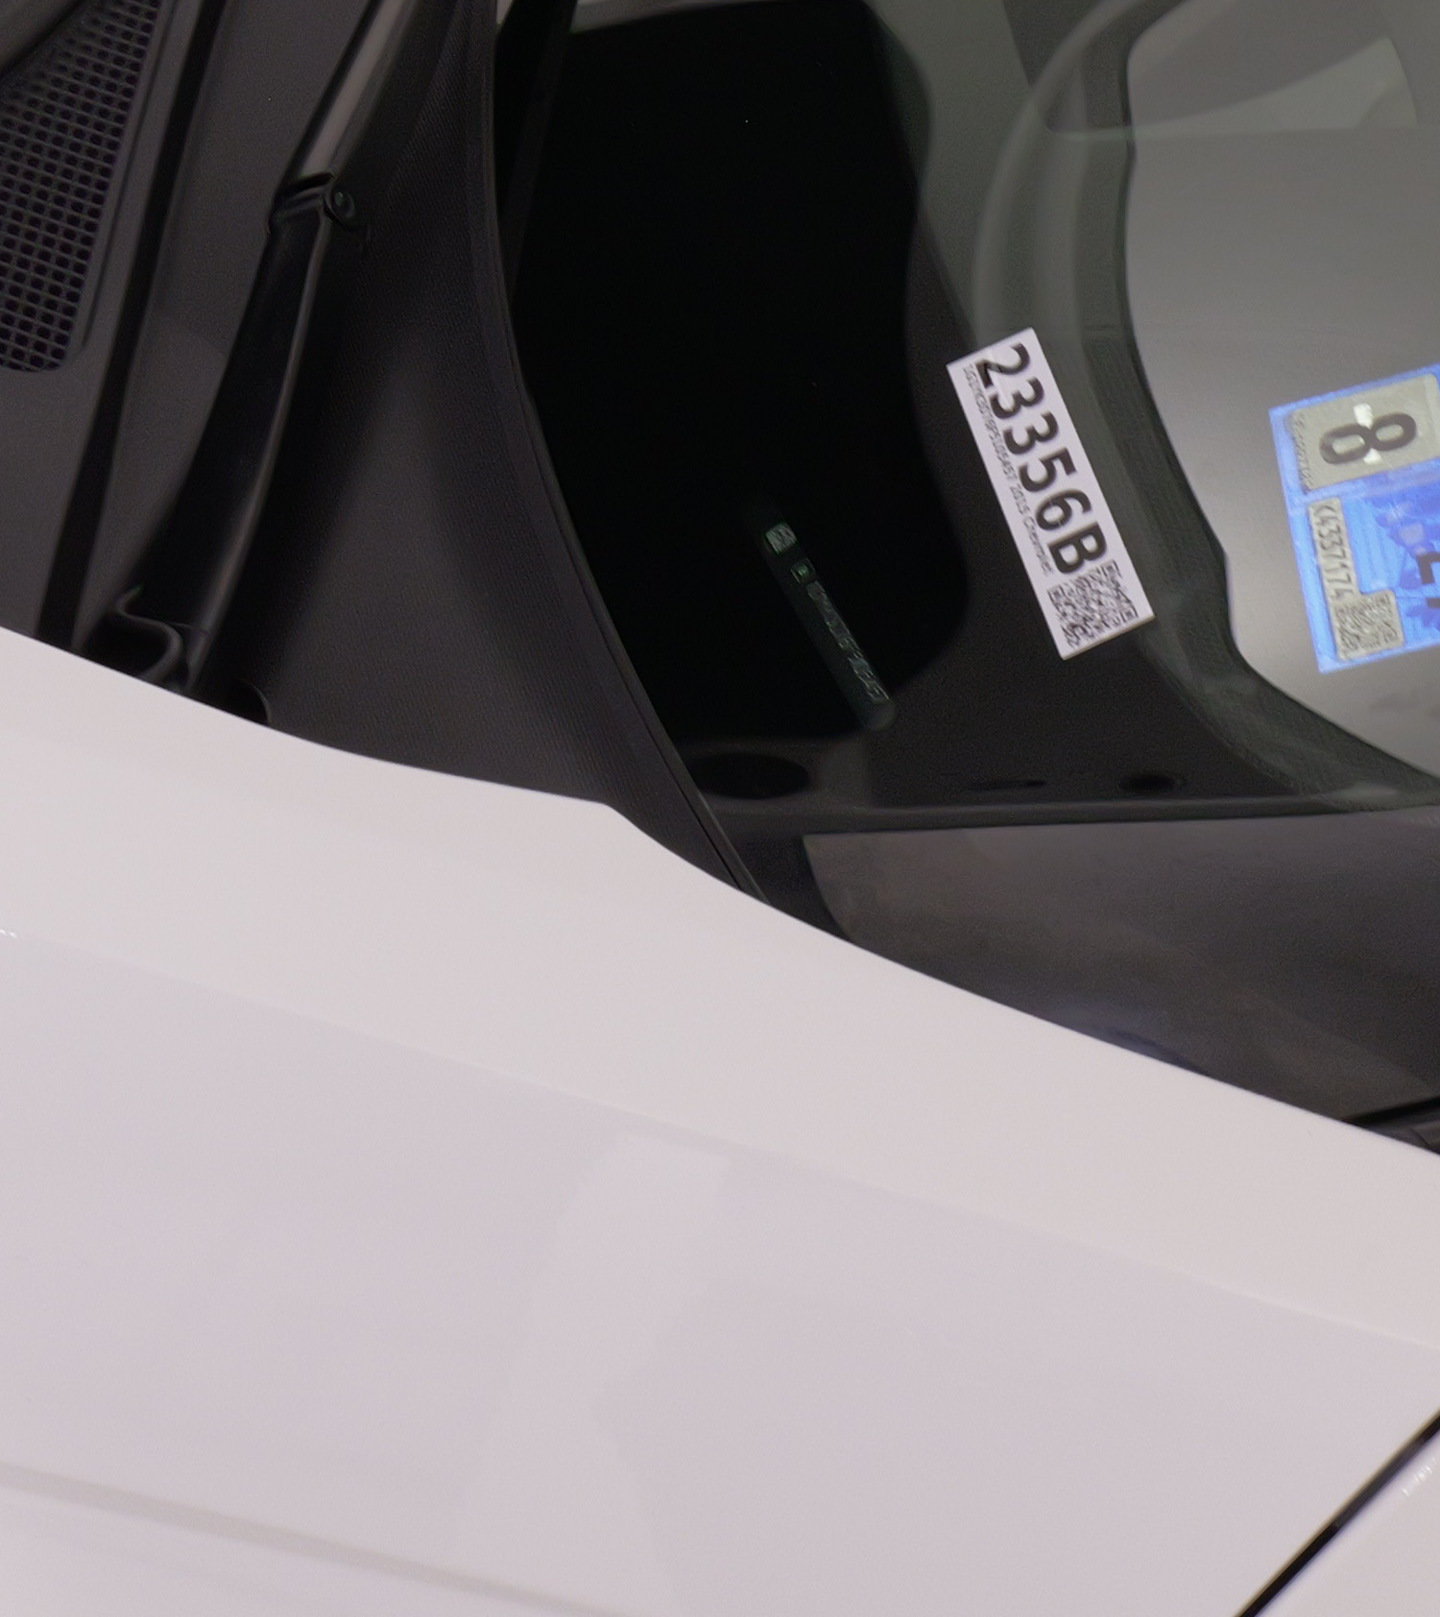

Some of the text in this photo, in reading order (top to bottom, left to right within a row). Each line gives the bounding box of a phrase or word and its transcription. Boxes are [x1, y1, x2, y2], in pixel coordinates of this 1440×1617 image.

[974, 342, 1108, 576] 23356B
[1319, 409, 1419, 467] 8
[1008, 481, 1031, 516] 2015
[1021, 514, 1054, 576] Chevrolet
